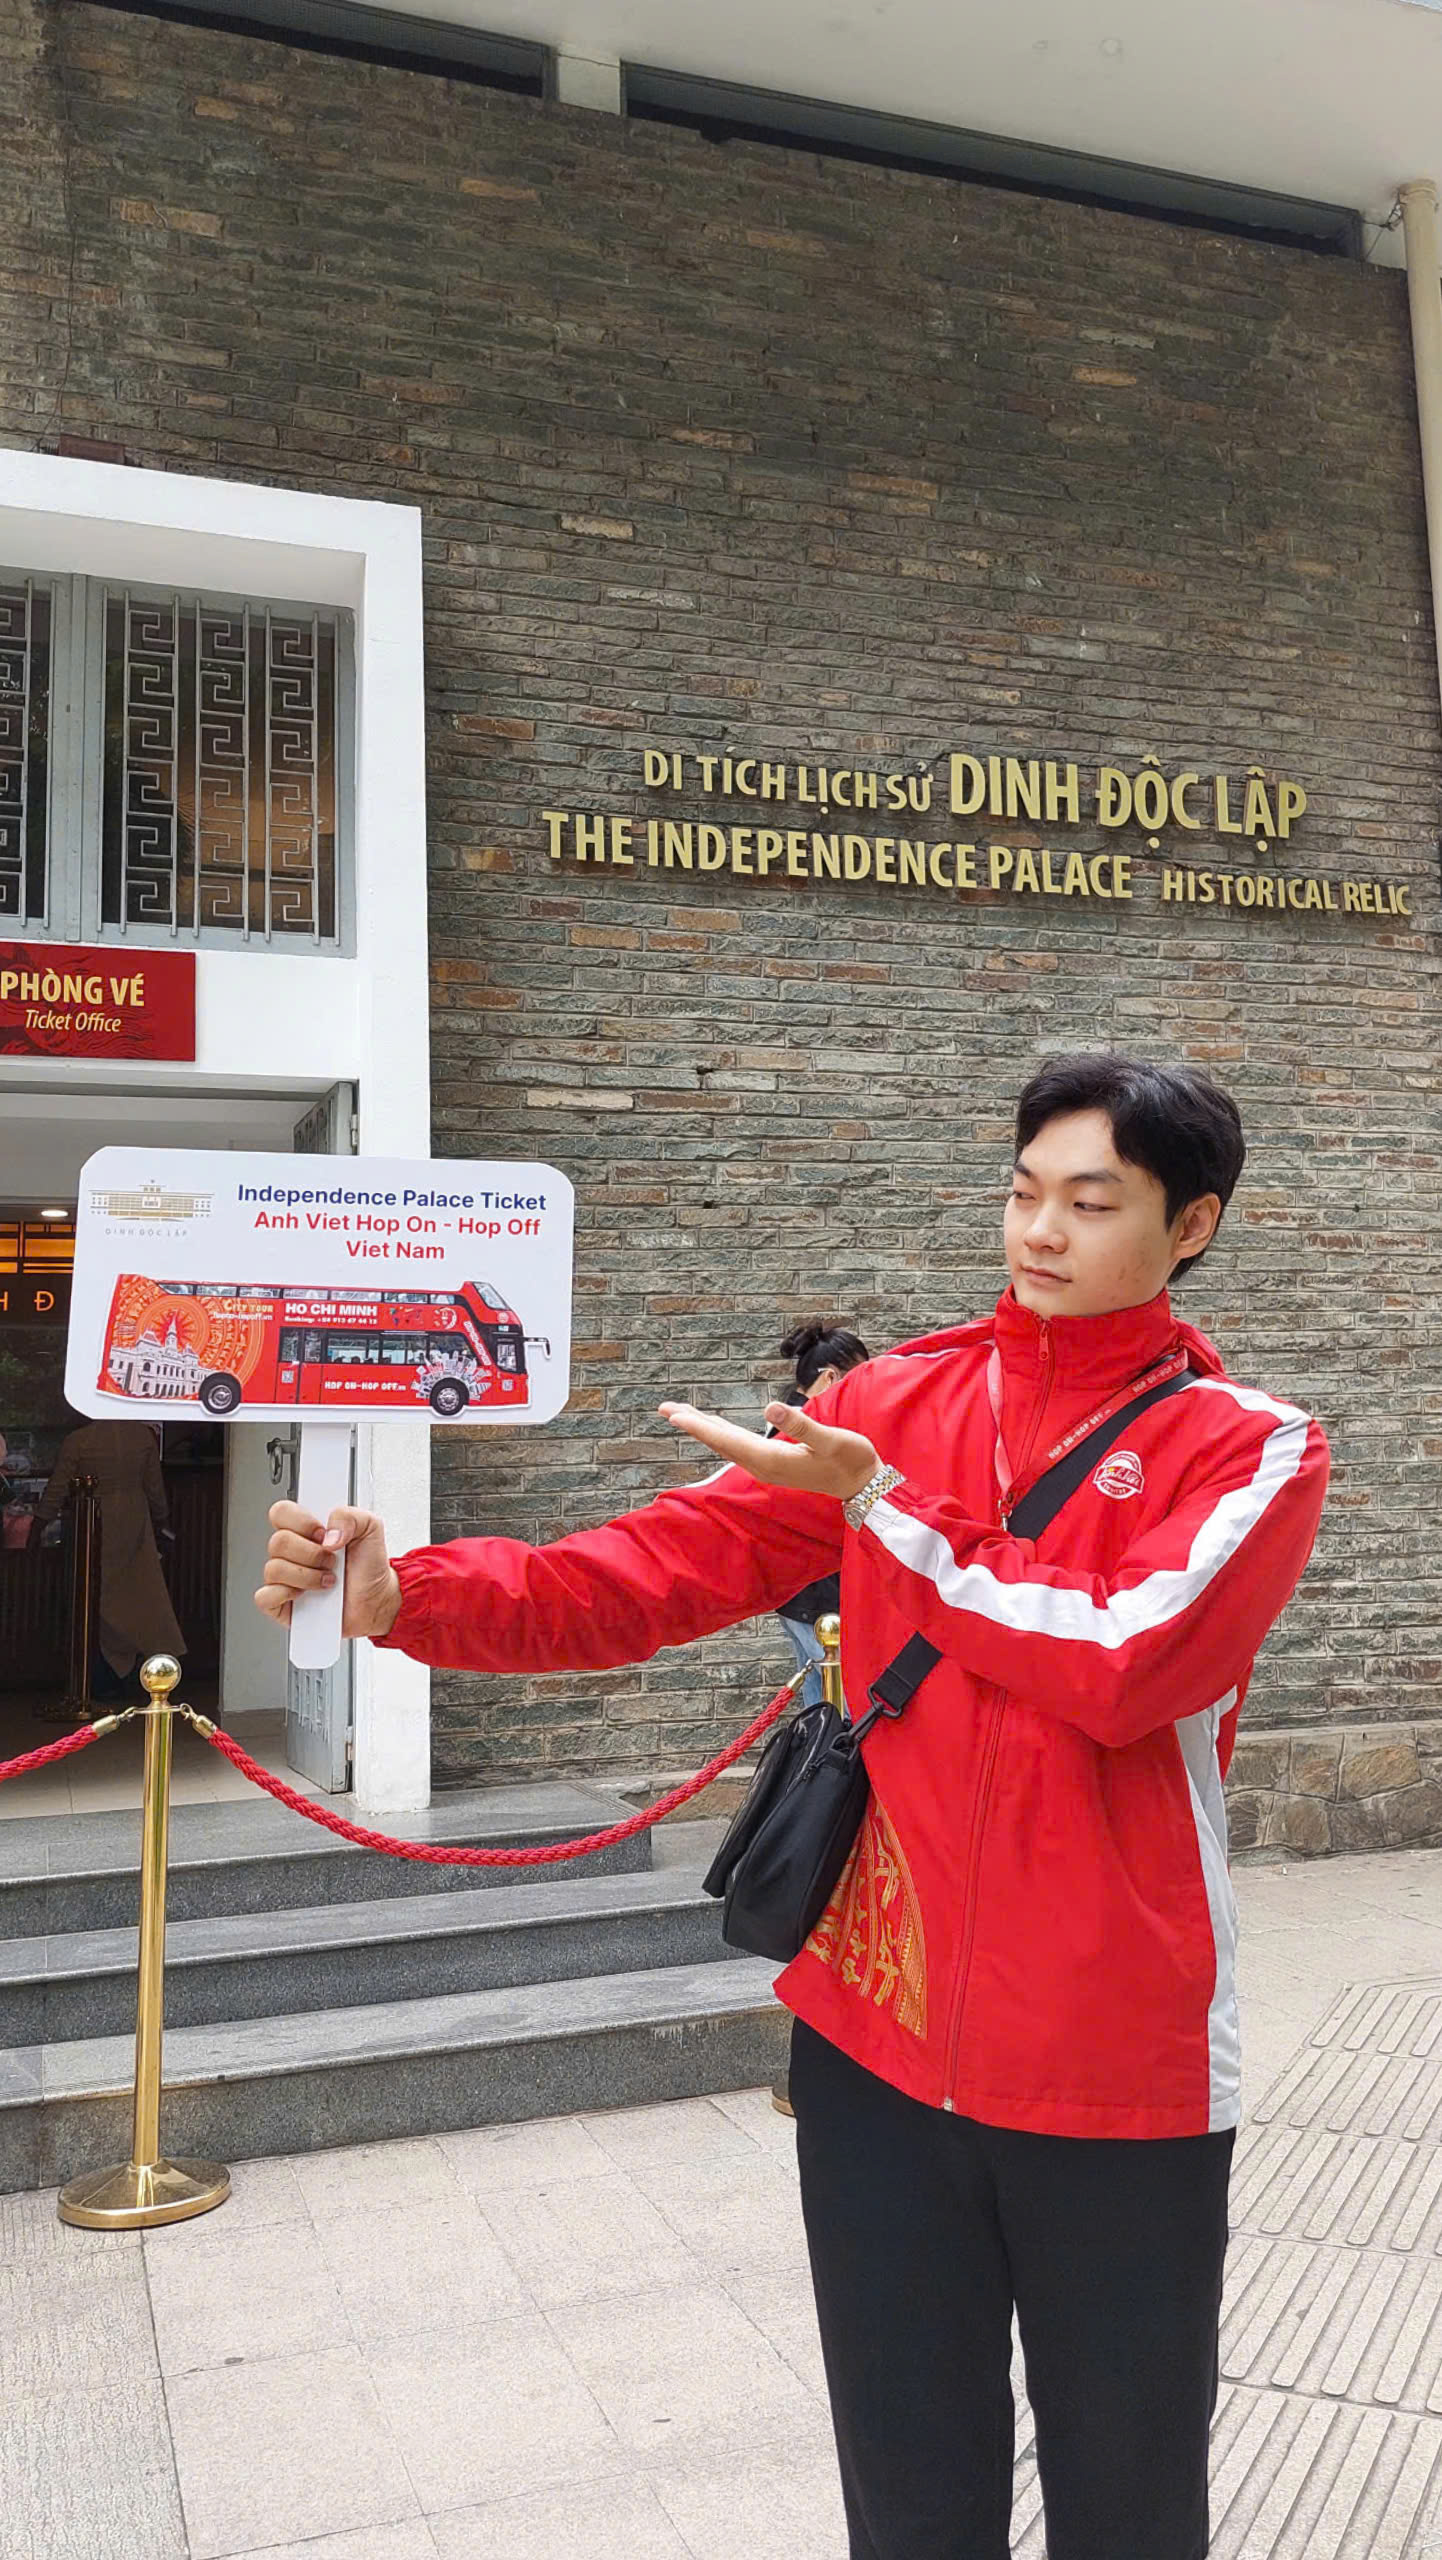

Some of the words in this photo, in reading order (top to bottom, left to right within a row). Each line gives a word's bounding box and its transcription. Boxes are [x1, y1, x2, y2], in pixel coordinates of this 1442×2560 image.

[644, 750, 682, 790] DI
[696, 746, 785, 800] TÍCH
[798, 766, 877, 814] LỊCH
[886, 761, 934, 812] SỬ
[951, 753, 1080, 823] DINH
[1095, 755, 1201, 849] ĐỘC
[1214, 766, 1307, 852] LẬP
[542, 811, 634, 865] THE
[648, 820, 978, 889] INDEPENDENCE
[990, 845, 1133, 899] PALACE
[1162, 869, 1338, 911] HISTORICAL
[1342, 881, 1413, 915] RELIC
[0, 968, 103, 1005] PHÒNG
[110, 973, 145, 1007] VÉ
[25, 1009, 71, 1031] Ticket
[75, 1012, 122, 1032] Office
[238, 1184, 397, 1207] Independence
[403, 1189, 474, 1208] Palace
[480, 1192, 547, 1210] Ticket
[254, 1211, 299, 1229] Anh
[305, 1212, 350, 1231] Viet
[356, 1214, 400, 1236] Hop
[406, 1215, 437, 1233] On
[458, 1217, 501, 1239] Hop
[507, 1218, 541, 1236] Off
[346, 1240, 390, 1258] Viet
[396, 1241, 445, 1260] Nam
[285, 1302, 307, 1314] HO
[310, 1303, 336, 1315] CHI
[339, 1304, 377, 1316] MINH
